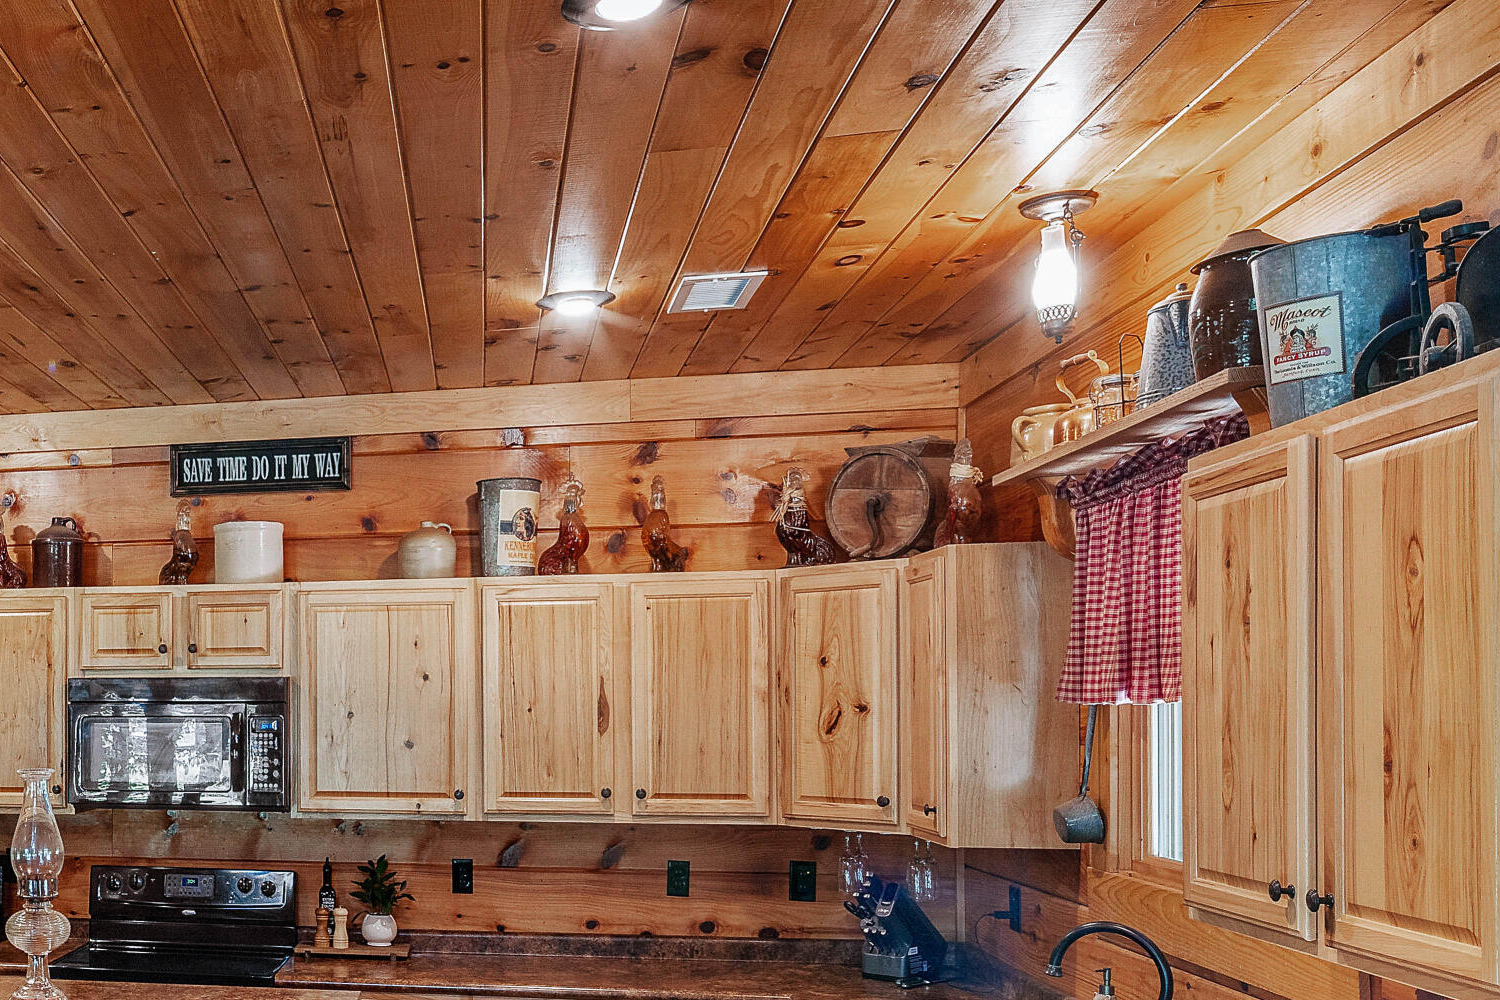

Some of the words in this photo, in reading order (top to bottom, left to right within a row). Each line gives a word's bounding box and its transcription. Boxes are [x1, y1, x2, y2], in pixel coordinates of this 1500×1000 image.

[1270, 306, 1332, 332] Mascot
[1276, 354, 1297, 363] FANCY
[1297, 349, 1326, 359] SYRUP
[183, 458, 213, 483] SAVE
[217, 456, 247, 482] TIME
[252, 455, 269, 480] DO
[274, 454, 287, 480] IT
[292, 454, 311, 479] MY
[314, 452, 341, 478] WAY
